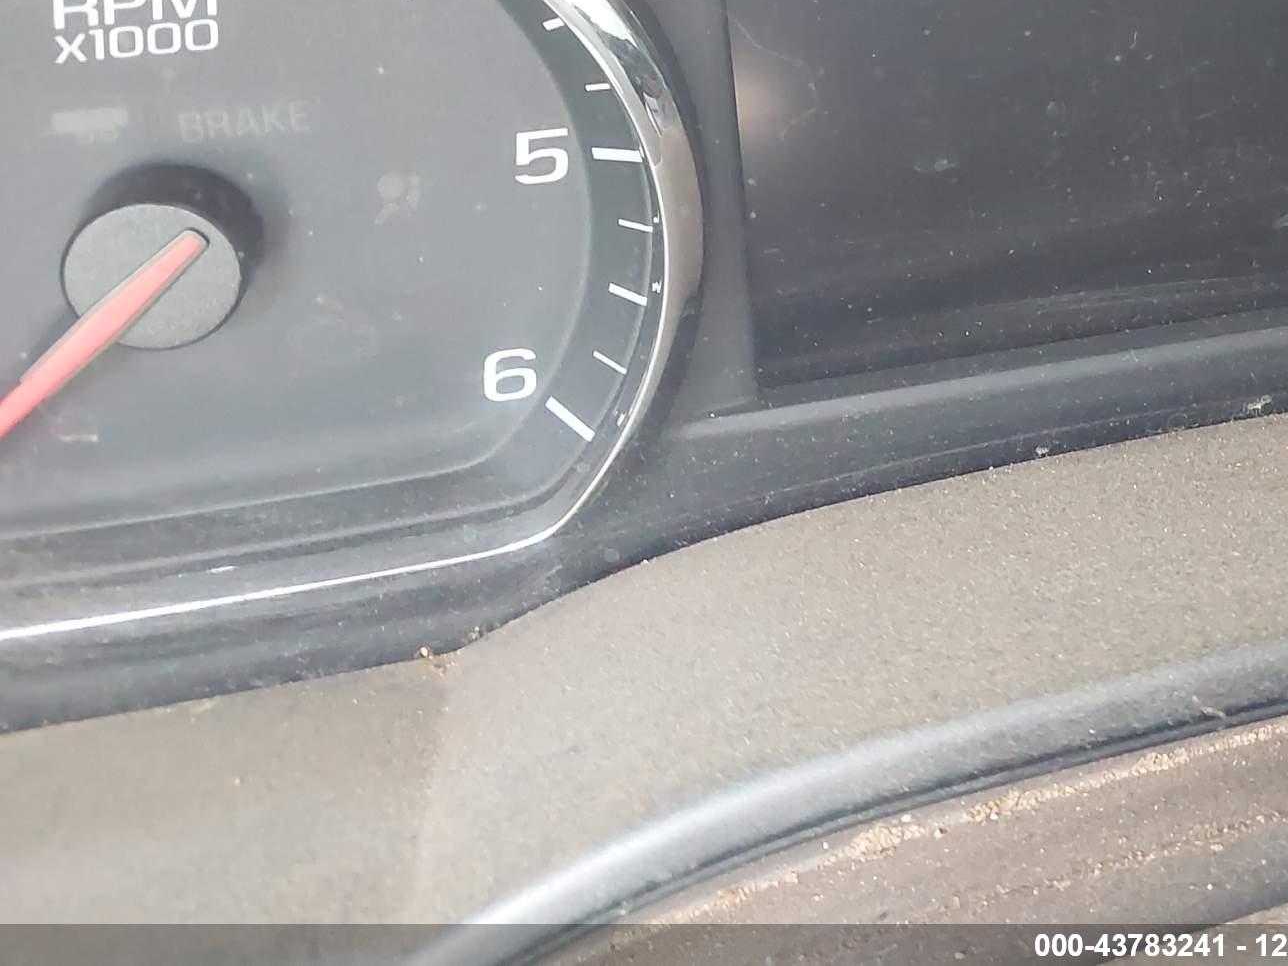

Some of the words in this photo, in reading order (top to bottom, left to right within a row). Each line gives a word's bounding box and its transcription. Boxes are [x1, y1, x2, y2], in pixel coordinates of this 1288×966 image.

[178, 97, 313, 144] BRAKE
[515, 128, 569, 185] 5
[483, 349, 538, 402] 6
